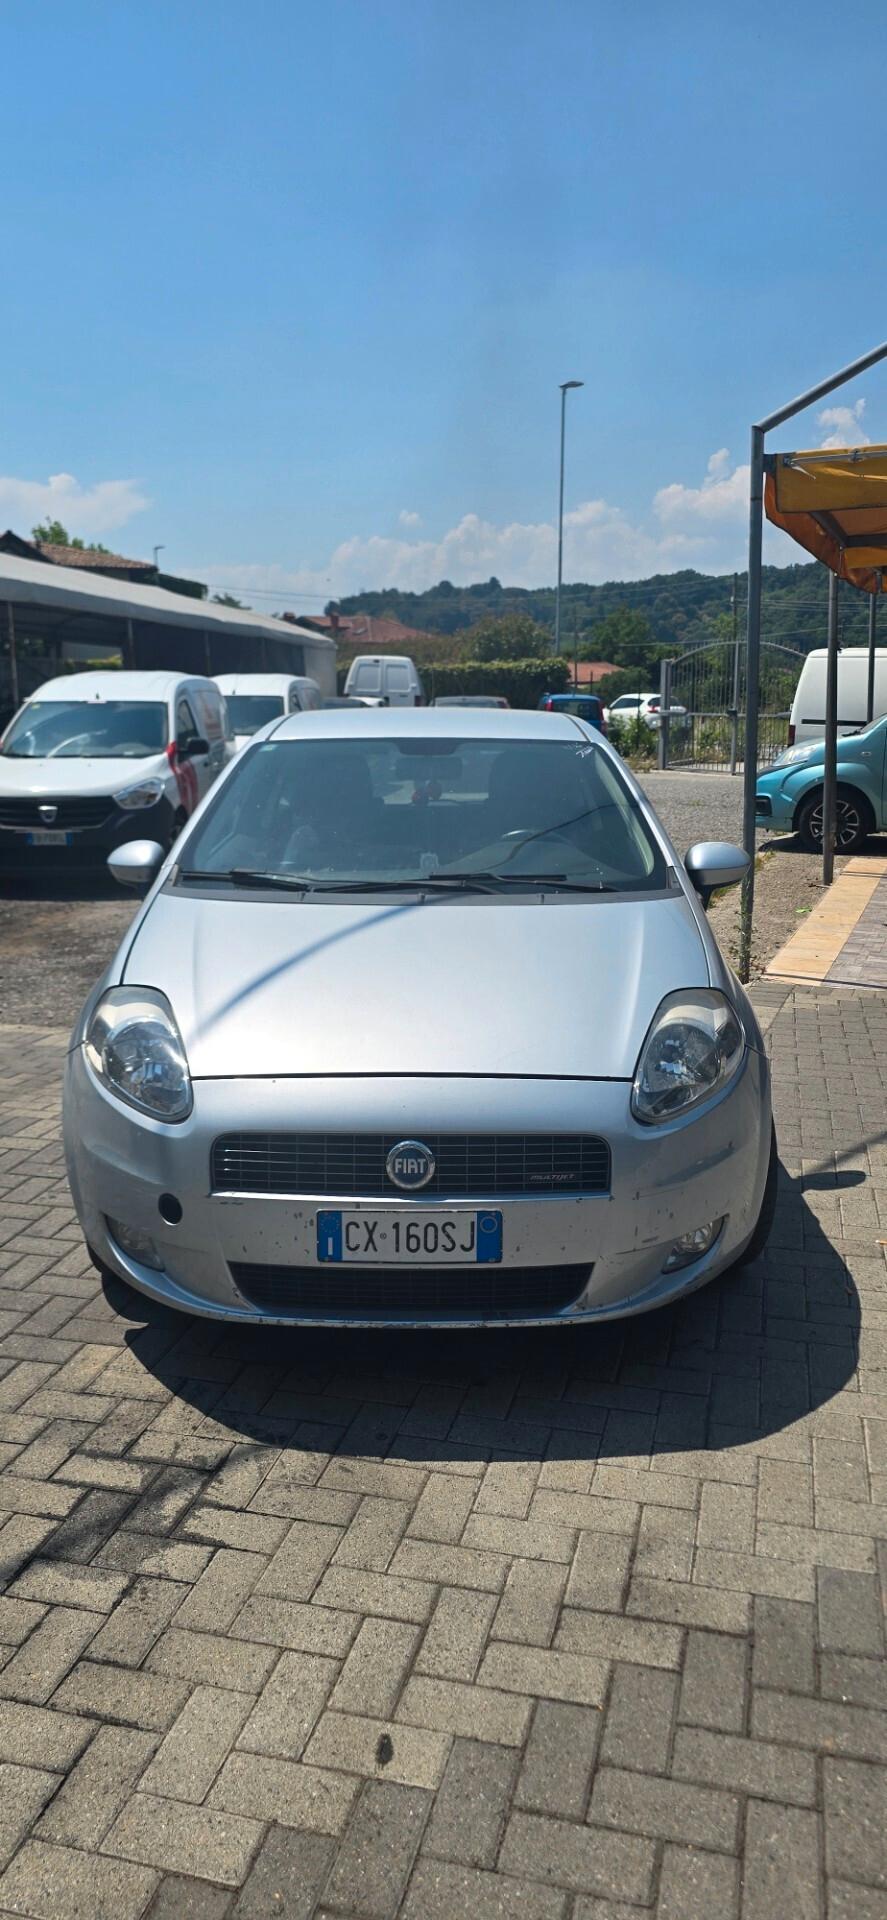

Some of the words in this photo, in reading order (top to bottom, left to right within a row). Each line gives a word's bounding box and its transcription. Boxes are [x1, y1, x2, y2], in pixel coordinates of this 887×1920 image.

[395, 1158, 426, 1174] FIAT
[345, 1221, 378, 1252] CX
[392, 1221, 475, 1253] 160SJ
